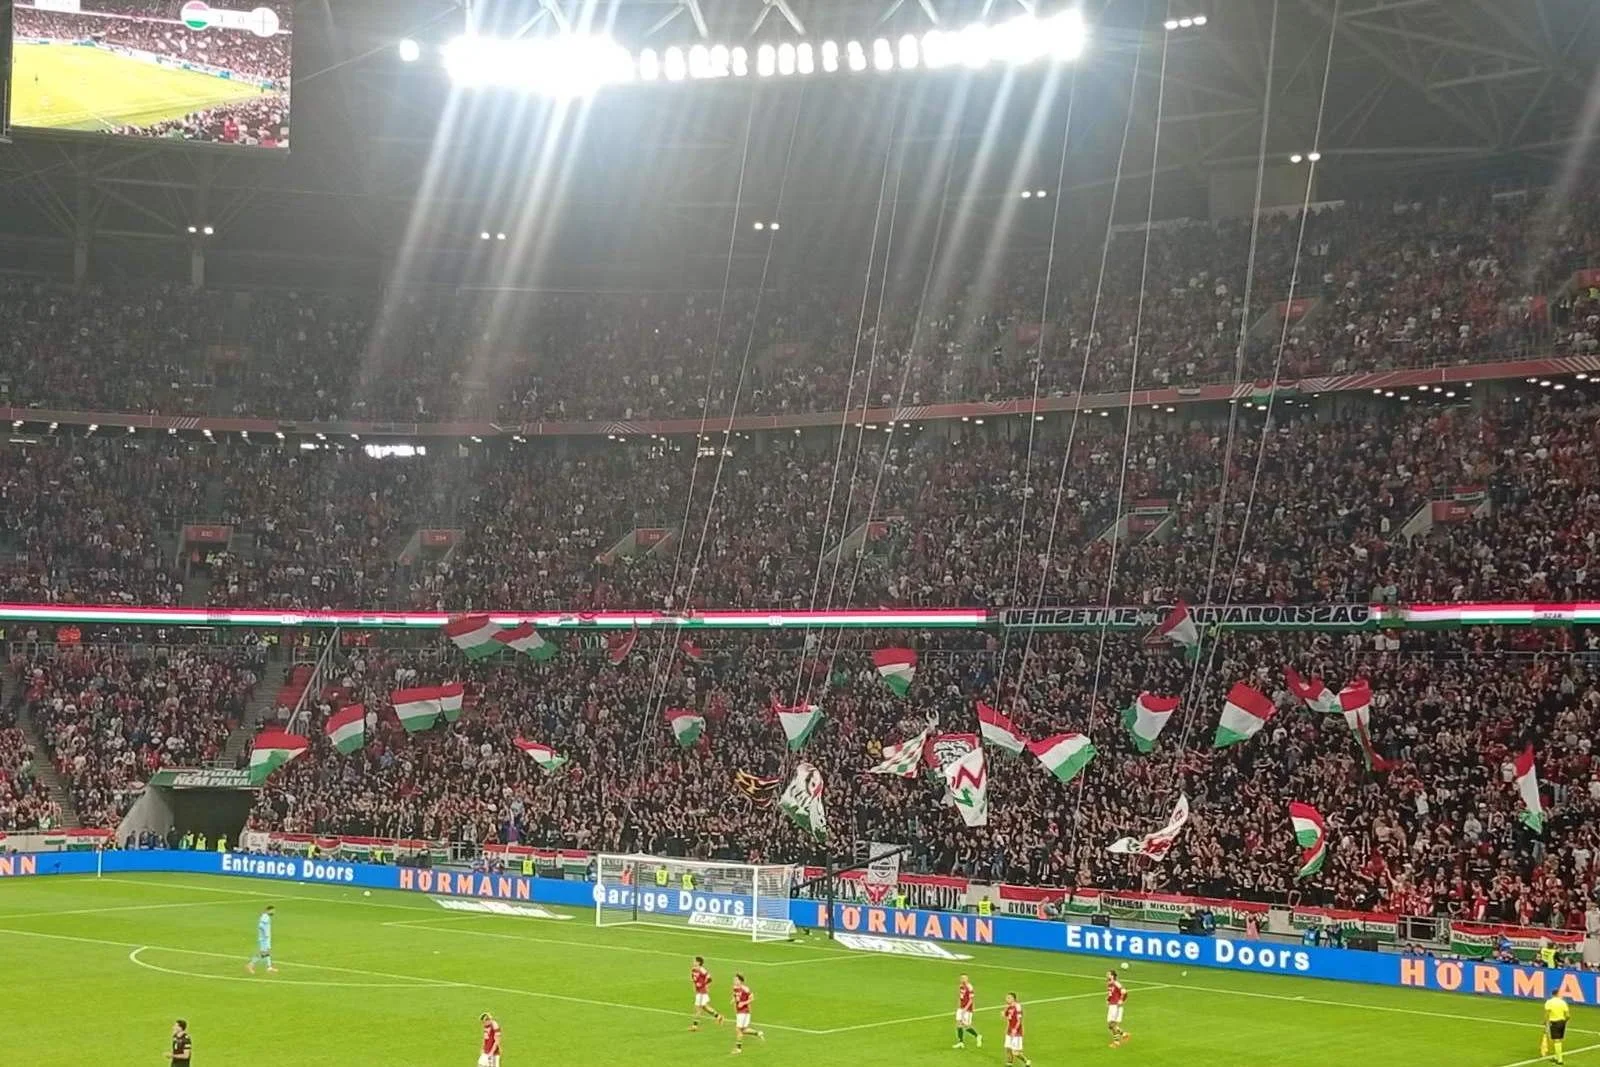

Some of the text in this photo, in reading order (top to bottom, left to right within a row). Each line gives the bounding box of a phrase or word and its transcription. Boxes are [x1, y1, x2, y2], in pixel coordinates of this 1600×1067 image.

[221, 853, 354, 881] Entrance Doors
[400, 868, 531, 900] HÖRMANN
[592, 883, 745, 916] Garage Doors
[817, 904, 993, 943] HÖRMANN
[1066, 924, 1309, 971] Entrance Doors
[1400, 955, 1600, 1004] HÖRMA
